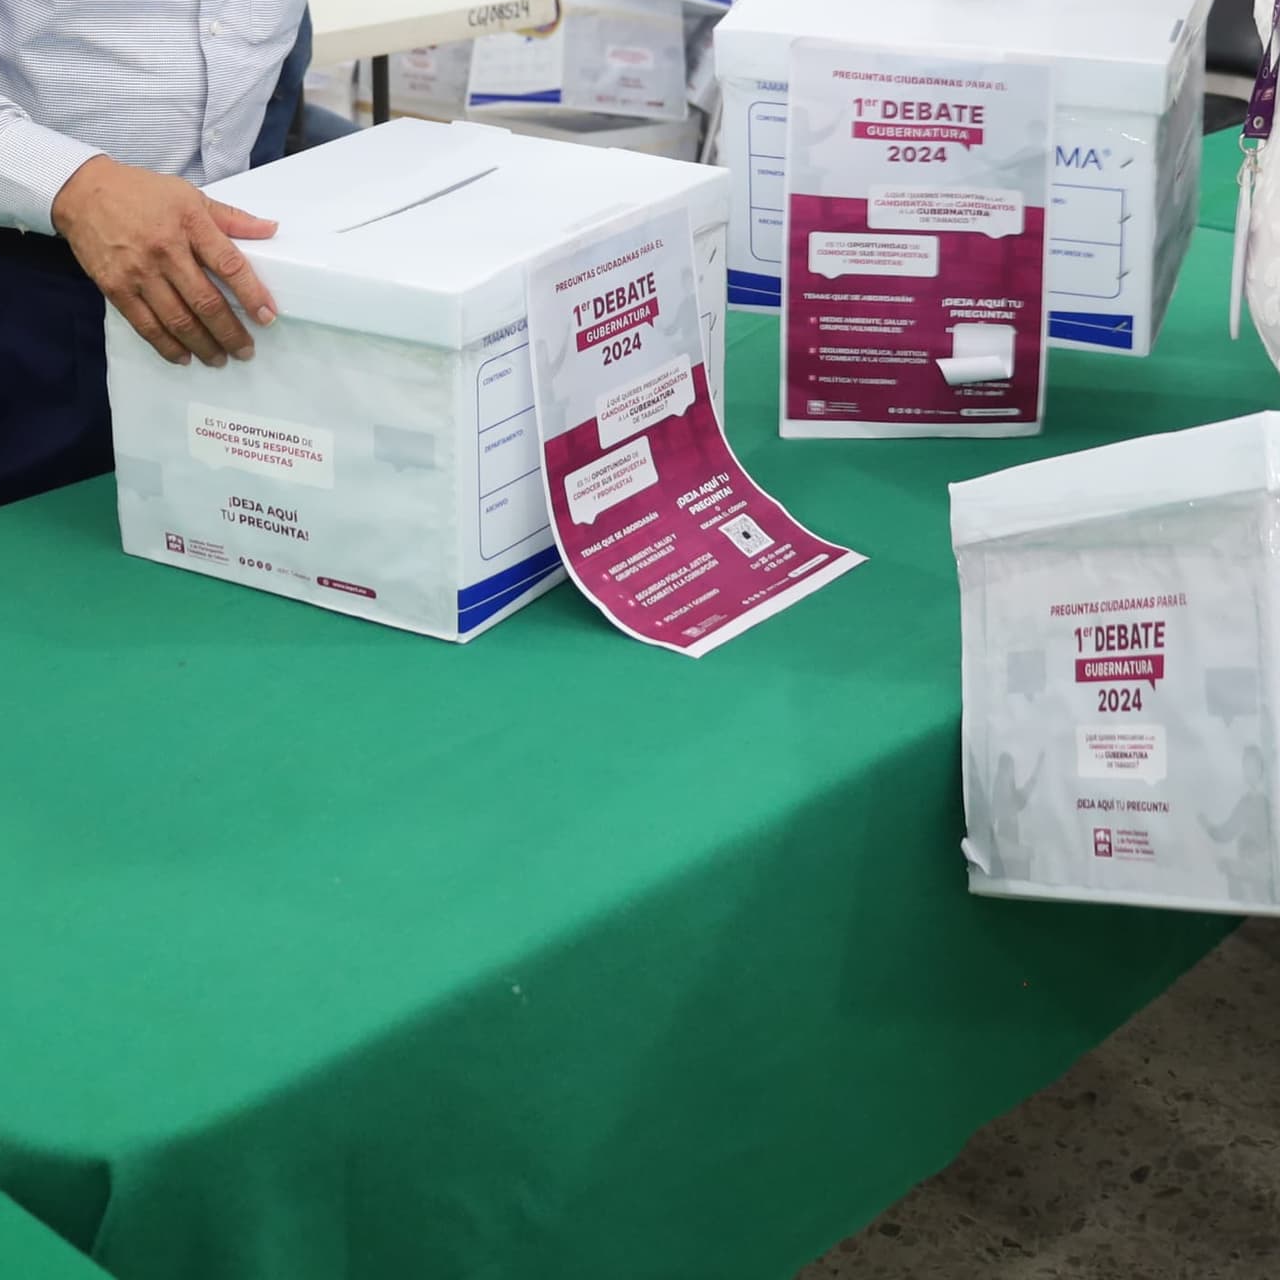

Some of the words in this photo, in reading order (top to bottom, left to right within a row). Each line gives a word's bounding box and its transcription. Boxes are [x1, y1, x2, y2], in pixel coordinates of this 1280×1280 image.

[832, 69, 892, 83] PREGUNTAS
[894, 75, 963, 88] CIUDADANAS
[965, 80, 992, 90] PARA
[852, 98, 878, 117] 1er
[881, 100, 985, 124] DEBATE
[866, 126, 969, 140] GUBERNATURA
[887, 146, 948, 163] 2024
[917, 208, 990, 217] GUBERNATURA
[555, 269, 595, 294] PREGUNTAS
[596, 250, 640, 276] CIUDADANAS
[640, 242, 655, 257] PARA
[655, 239, 664, 249] EL
[572, 299, 591, 327] 1er
[593, 271, 657, 321] DEBATE
[976, 298, 1006, 308] AQUÍ
[1007, 299, 1024, 308] TU
[586, 304, 651, 343] GUBERNATURA
[601, 332, 642, 367] 2024
[601, 396, 640, 421] CANDIDATAS
[653, 371, 688, 395] CANDIDATOS
[629, 388, 675, 416] GUBERNATURA
[195, 427, 240, 444] CONOCER
[242, 437, 261, 449] SUS
[263, 441, 323, 462] RESPUESTAS
[204, 417, 214, 427] ES
[216, 420, 227, 429] TU
[228, 422, 300, 444] OPORTUNIDAD
[302, 437, 313, 447] DE
[231, 448, 294, 468] PROPUESTAS
[591, 454, 631, 480] OPORTUNIDAD
[573, 481, 600, 501] CONOCER
[613, 457, 647, 480] RESPUESTAS
[597, 476, 633, 499] PROPUESTAS
[676, 489, 700, 509] ¡DEJA
[699, 476, 720, 496] AQUÍ
[717, 472, 730, 484] TU
[229, 496, 264, 513] ¡DEJA
[267, 504, 298, 523] AQUÍ
[688, 486, 733, 515] PREGUNTA!
[220, 508, 236, 522] TU
[239, 514, 310, 541] PREGUNTA!
[581, 542, 602, 558] TEMAS
[601, 535, 616, 547] QUE
[1050, 602, 1099, 616] PREGUNTAS
[1100, 597, 1155, 613] CIUDADANAS
[1157, 594, 1178, 607] PARA
[1178, 592, 1187, 606] EL
[1074, 626, 1093, 653] 1er
[1095, 621, 1165, 652] DEBATE
[1084, 659, 1153, 677] GUBERNATURA
[1098, 688, 1142, 712] 2024
[1105, 751, 1148, 759] GUBERNATURA
[1097, 798, 1114, 811] AQUÍ
[1116, 801, 1125, 810] TU
[1126, 801, 1169, 812] PREGUNTA!
